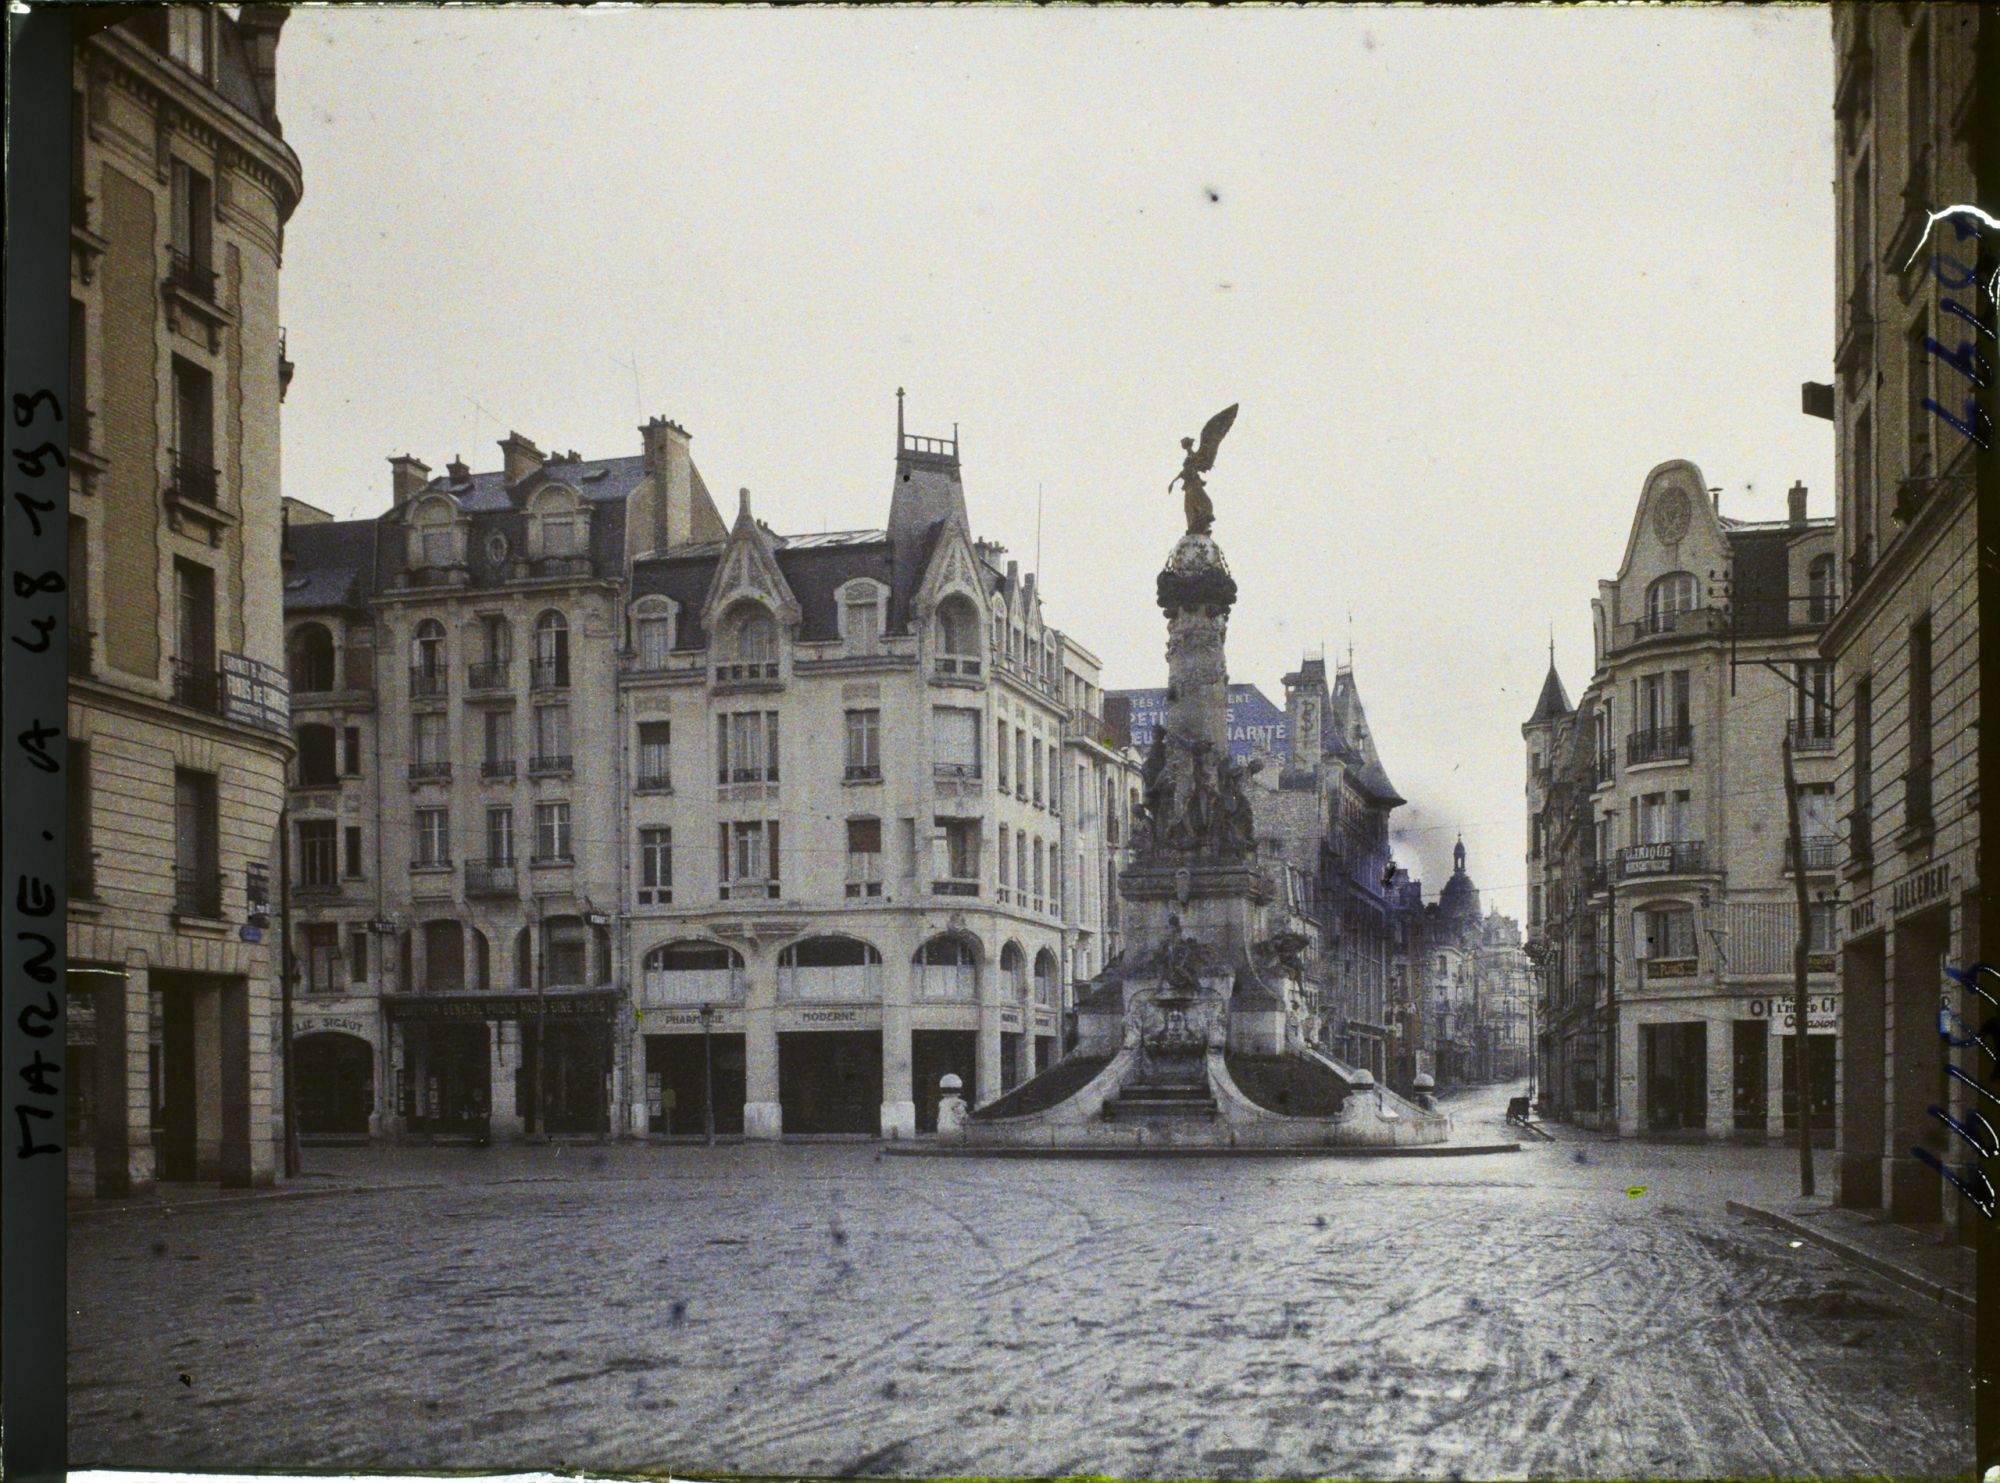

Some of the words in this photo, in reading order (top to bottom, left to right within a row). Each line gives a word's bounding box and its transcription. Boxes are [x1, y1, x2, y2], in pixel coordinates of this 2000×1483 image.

[1131, 697, 1154, 708] TÉS
[1227, 694, 1251, 704] ENT
[30, 719, 59, 773] A
[520, 1000, 548, 1014] RADO
[665, 1015, 725, 1025] PHARMIE
[803, 1012, 856, 1021] MODERNE
[1784, 1015, 1837, 1029] Oasion
